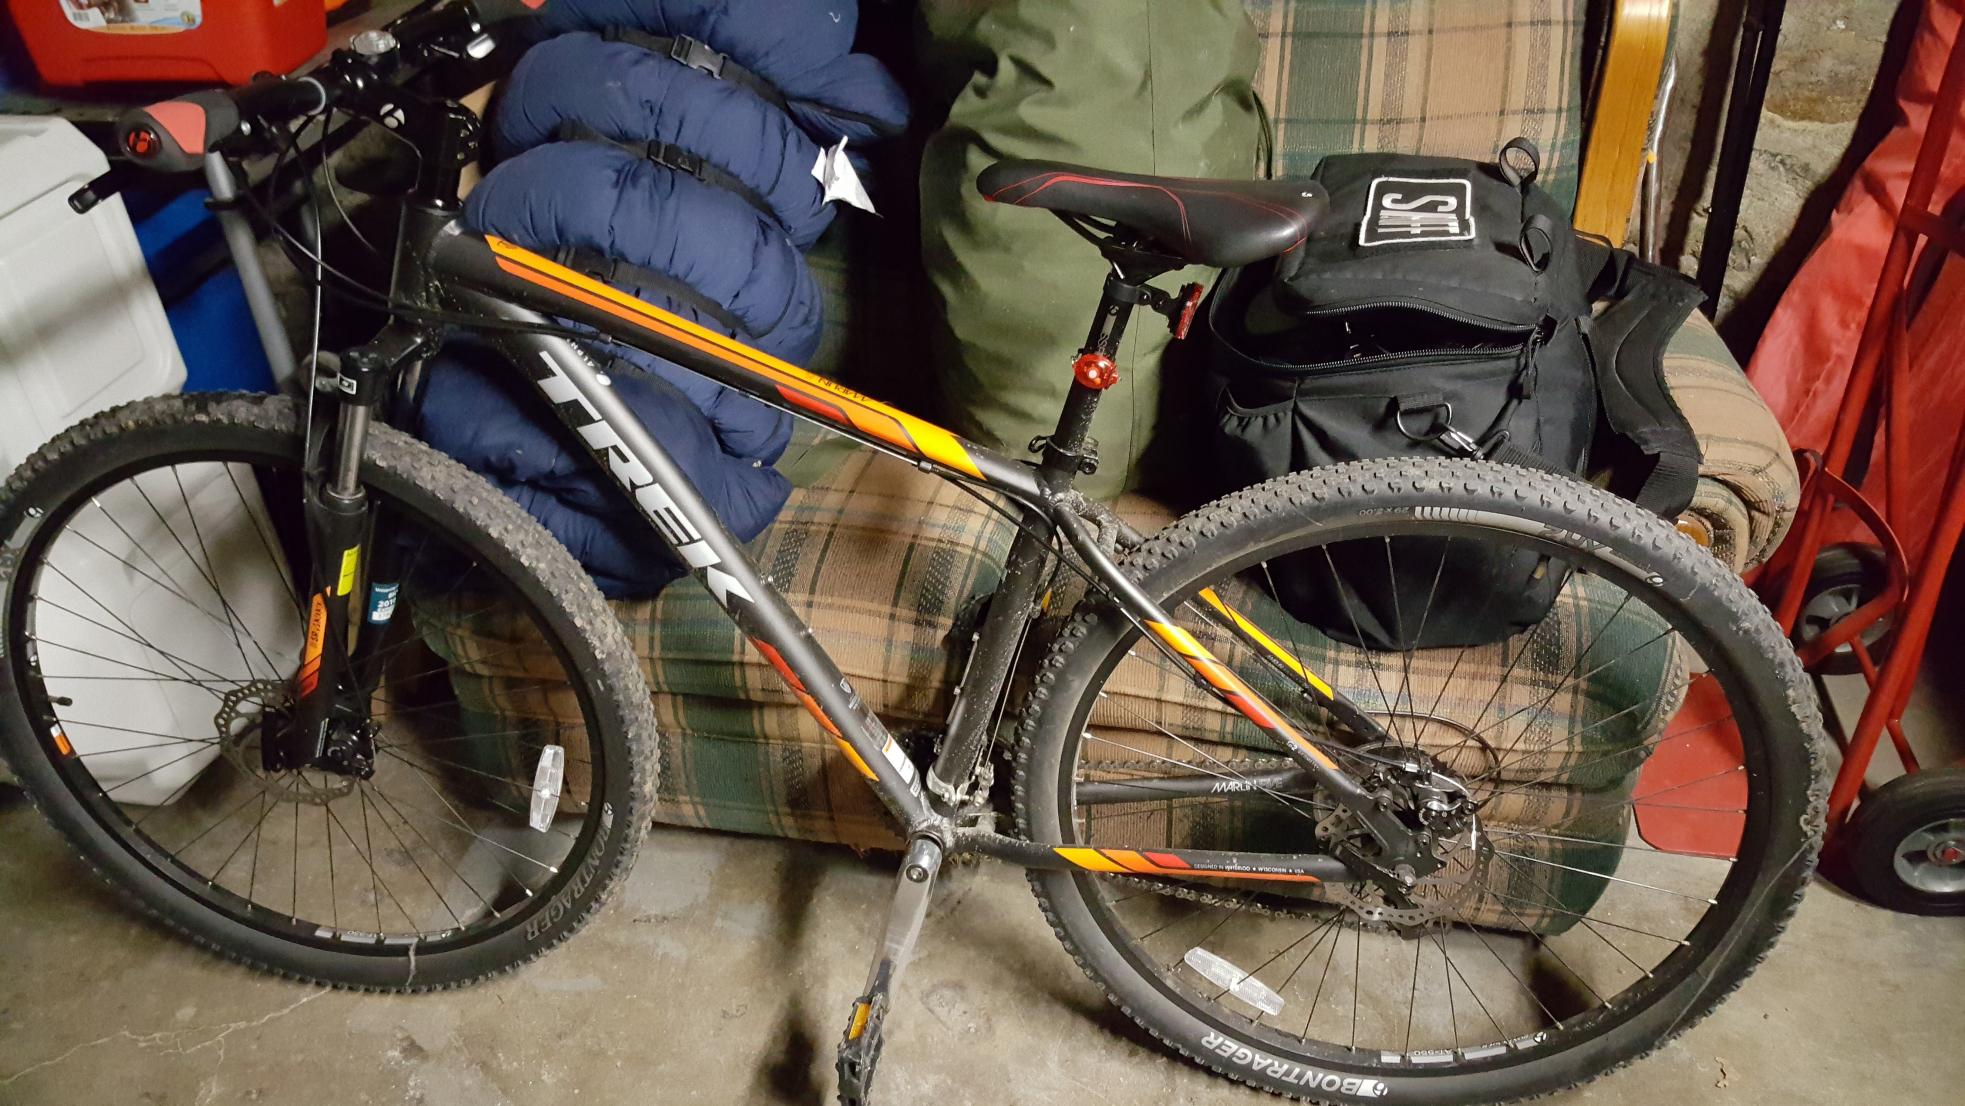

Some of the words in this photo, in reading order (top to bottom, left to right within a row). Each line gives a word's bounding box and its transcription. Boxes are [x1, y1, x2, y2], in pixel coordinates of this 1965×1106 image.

[537, 350, 756, 608] TREK
[1211, 779, 1257, 793] MARLIN
[1201, 1032, 1362, 1096] BONTRAGER
